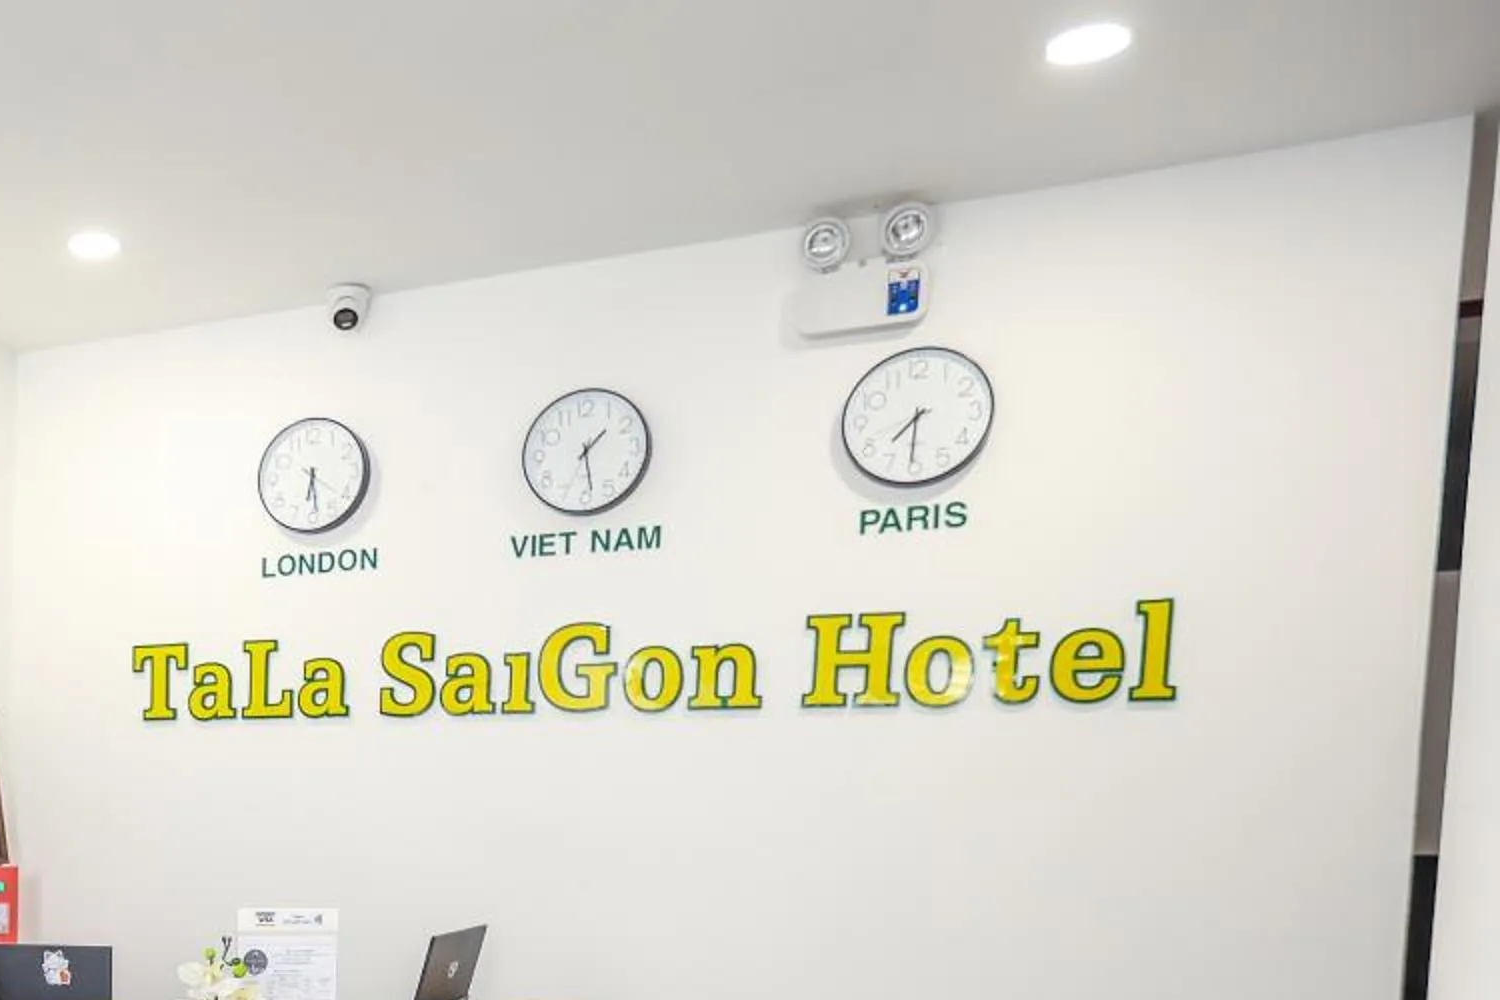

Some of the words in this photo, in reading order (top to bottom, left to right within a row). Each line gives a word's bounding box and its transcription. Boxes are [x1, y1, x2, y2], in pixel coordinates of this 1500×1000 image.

[885, 368, 901, 390] 11
[908, 359, 929, 380] 12
[957, 376, 975, 398] 2
[862, 386, 887, 411] 10
[968, 400, 983, 421] 3
[954, 426, 970, 446] 4
[882, 453, 896, 474] 7
[936, 447, 951, 468] 5
[859, 502, 968, 535] PARIS
[510, 531, 578, 558] VIET
[590, 525, 662, 553] NAM
[261, 548, 378, 578] LONDON
[132, 640, 350, 721] TaLa
[802, 597, 1177, 708] Hotel
